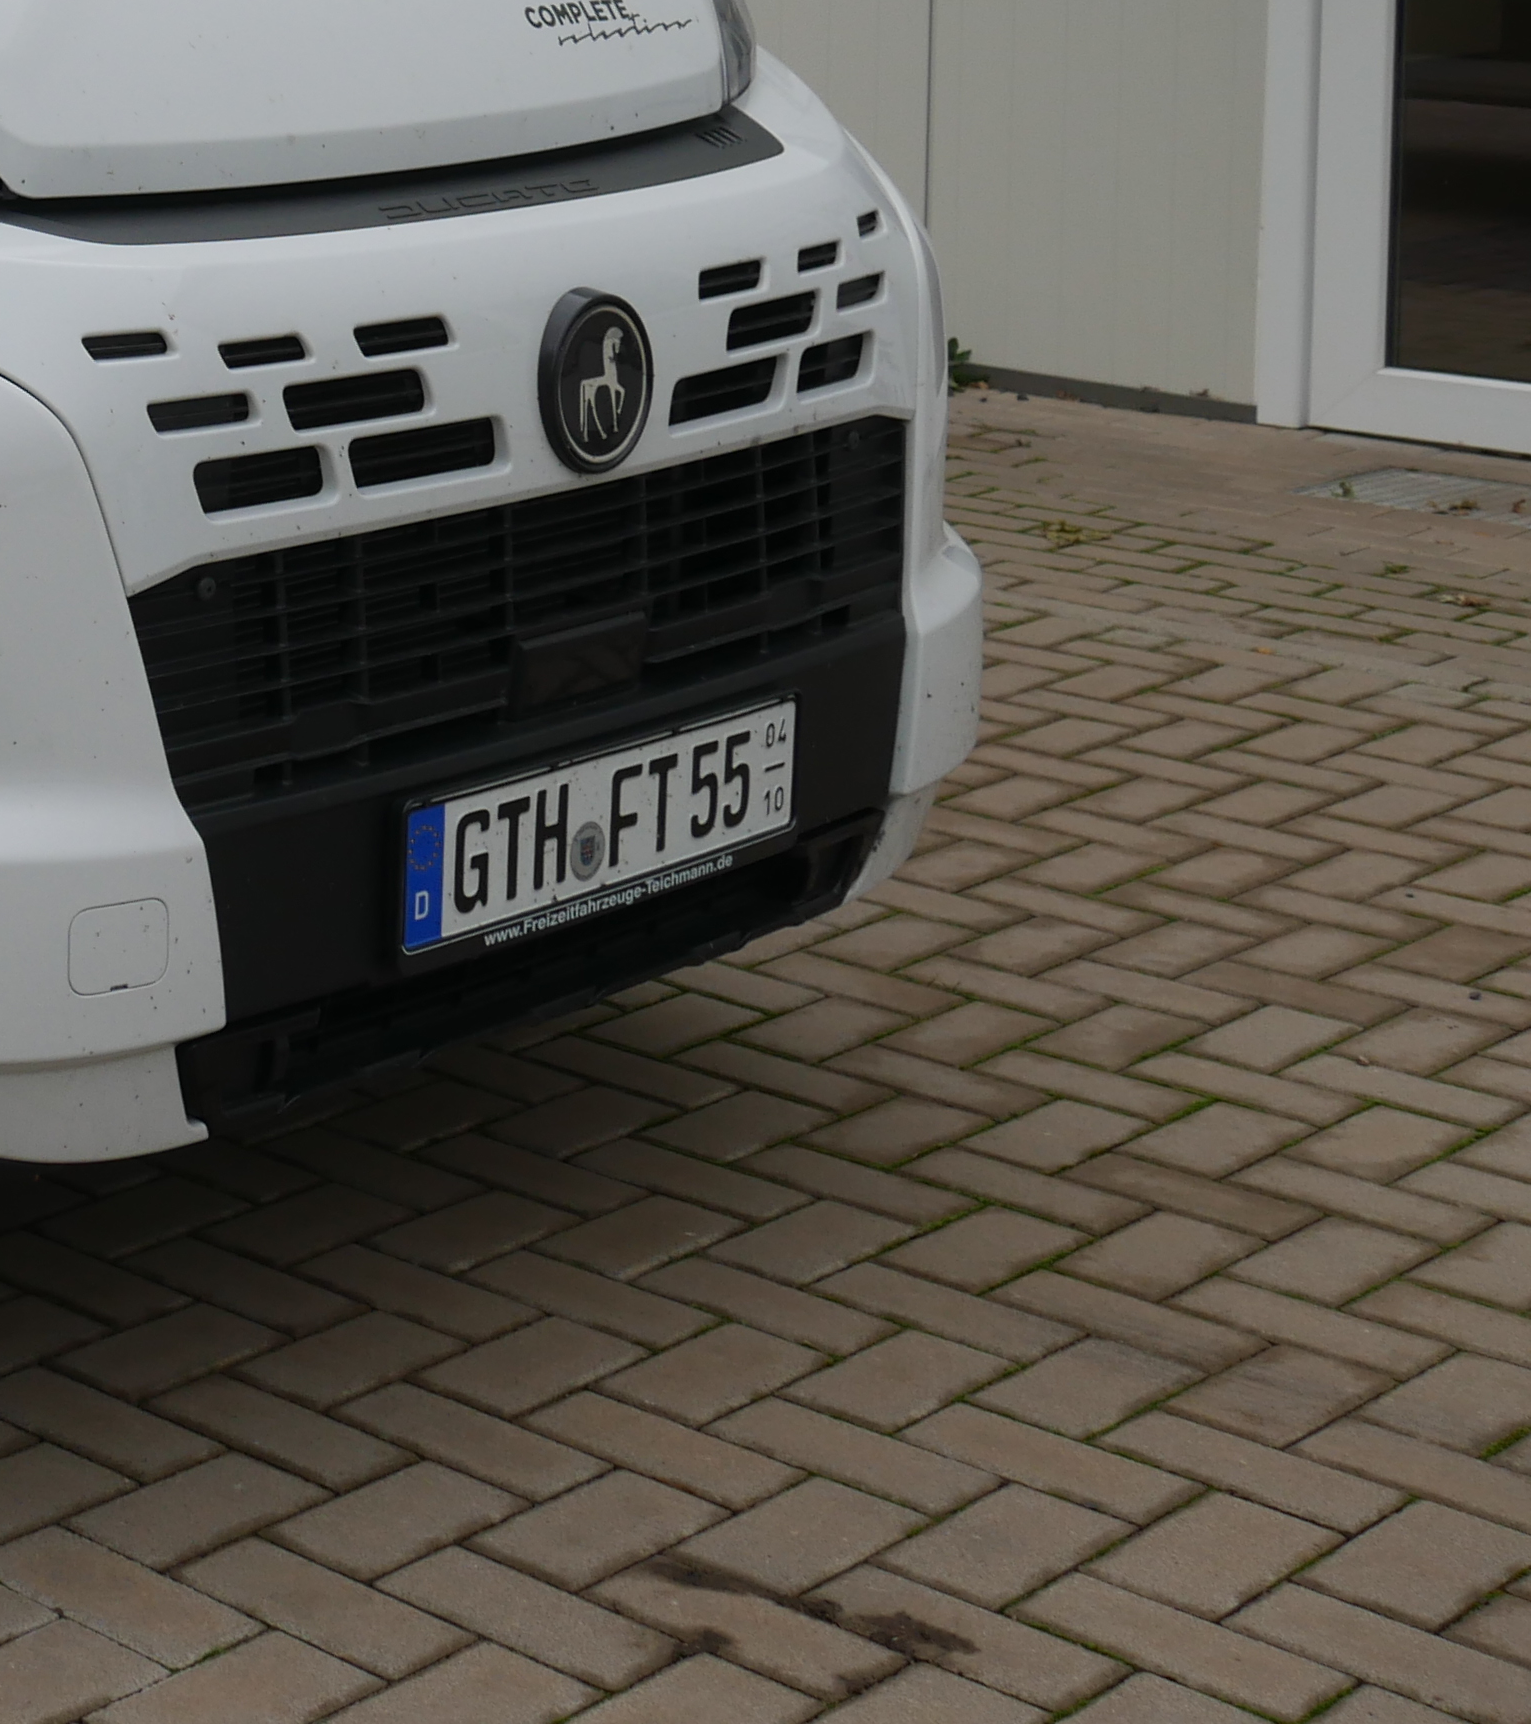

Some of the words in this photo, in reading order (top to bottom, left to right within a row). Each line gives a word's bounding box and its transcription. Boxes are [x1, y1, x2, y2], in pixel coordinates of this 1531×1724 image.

[765, 719, 787, 746] 04
[763, 786, 784, 816] 10
[415, 890, 429, 921] D
[453, 783, 570, 914] GTH
[484, 853, 734, 947] www.Freizeitfahrzeuge-Teichmann.de
